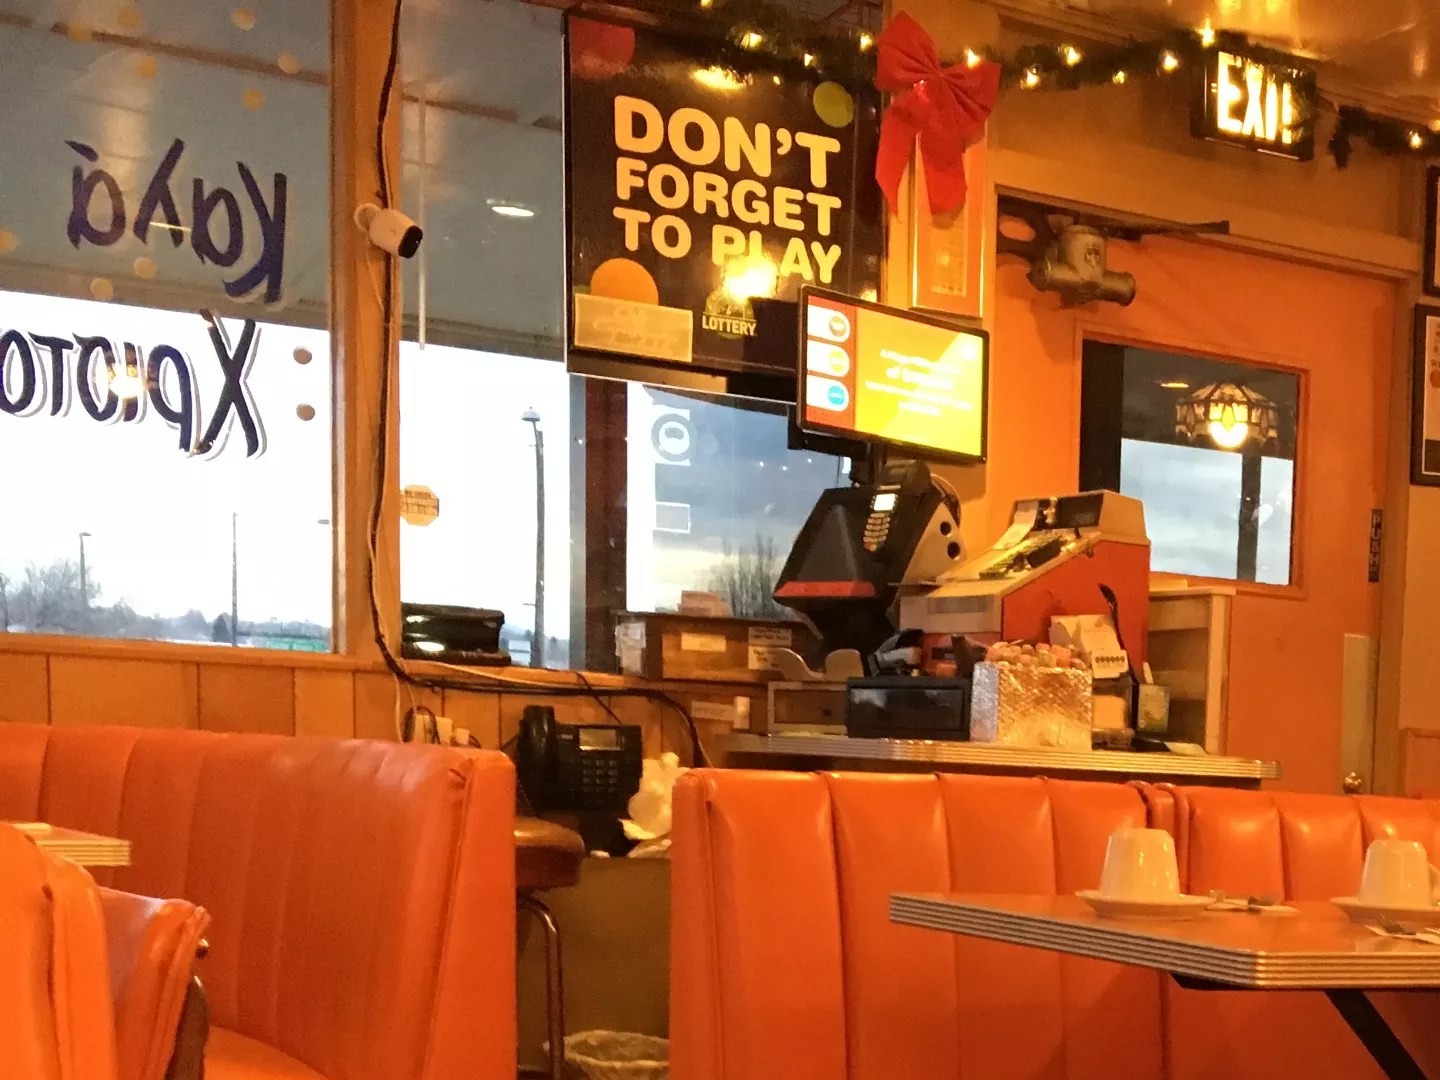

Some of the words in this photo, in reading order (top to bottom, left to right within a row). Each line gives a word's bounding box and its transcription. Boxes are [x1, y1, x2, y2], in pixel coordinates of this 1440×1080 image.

[613, 94, 841, 189] DON'T
[615, 156, 842, 237] FORGET
[612, 206, 692, 260] TO
[711, 224, 842, 285] PLAY
[702, 315, 757, 337] LOTTERY
